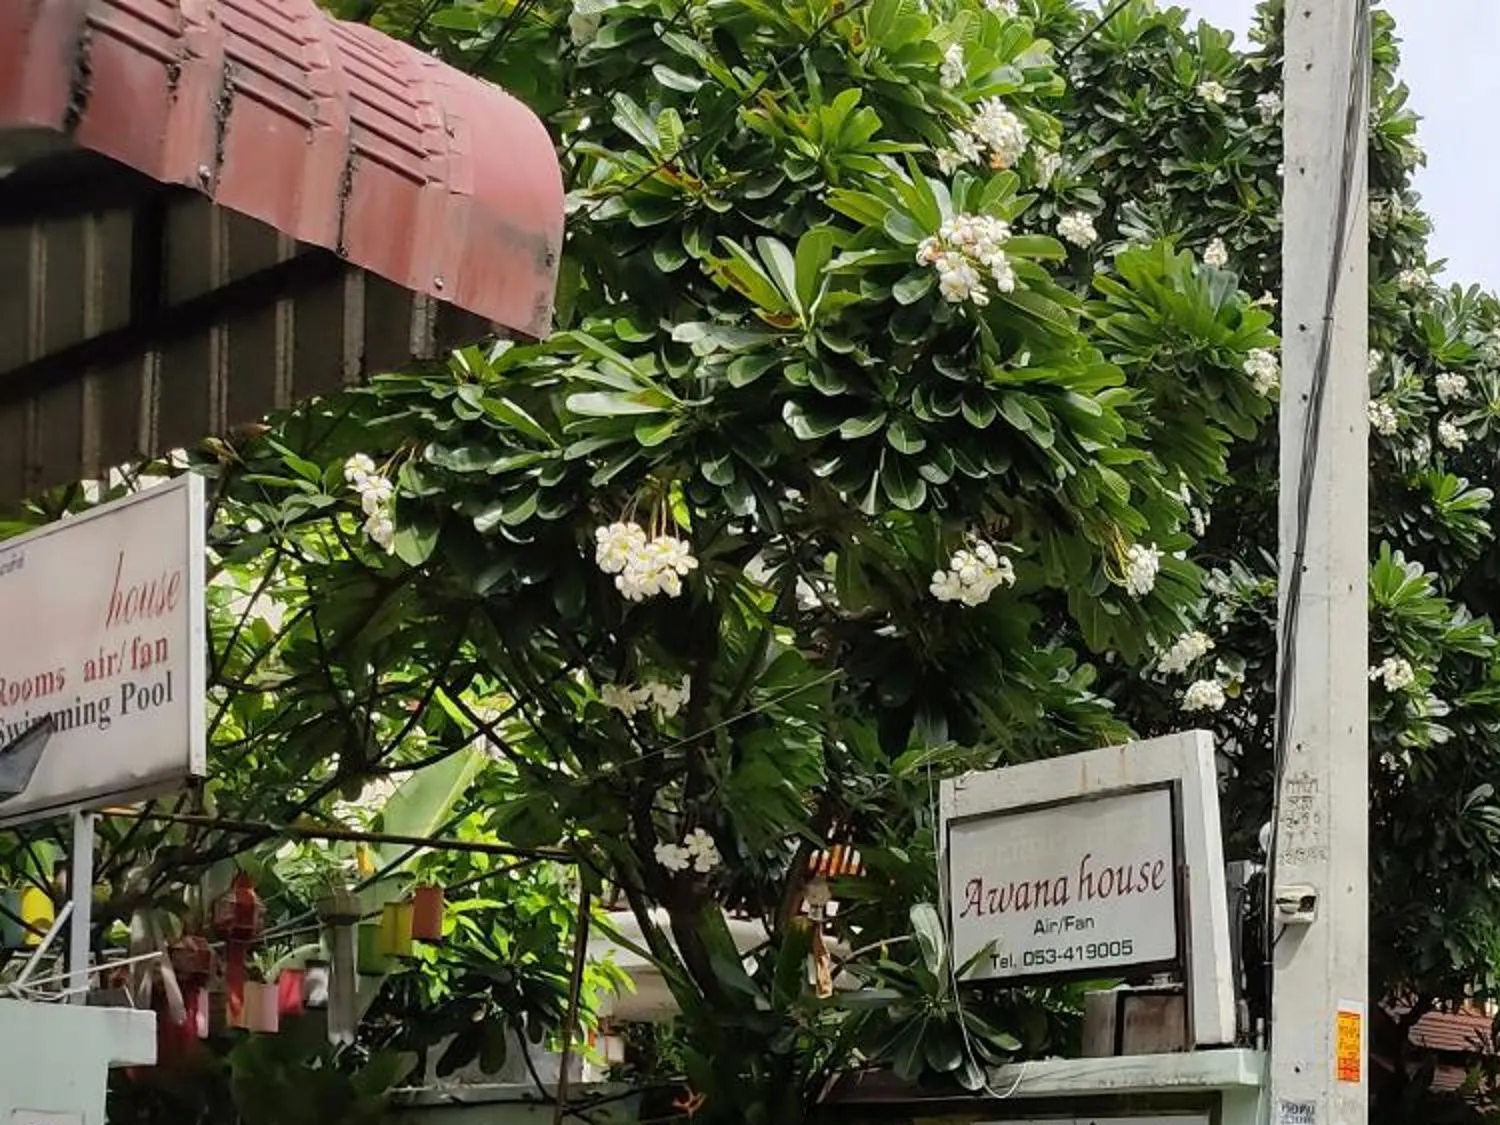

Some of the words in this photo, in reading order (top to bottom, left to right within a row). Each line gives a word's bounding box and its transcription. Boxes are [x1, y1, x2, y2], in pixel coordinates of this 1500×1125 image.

[105, 550, 182, 631] house
[83, 635, 169, 681] air/fan
[120, 671, 173, 715] Pool
[959, 874, 1070, 919] Awana
[1078, 853, 1166, 901] house
[1033, 915, 1095, 935] Air/Fan
[990, 952, 1017, 970] Tel.
[1023, 939, 1133, 966] 053-419005
